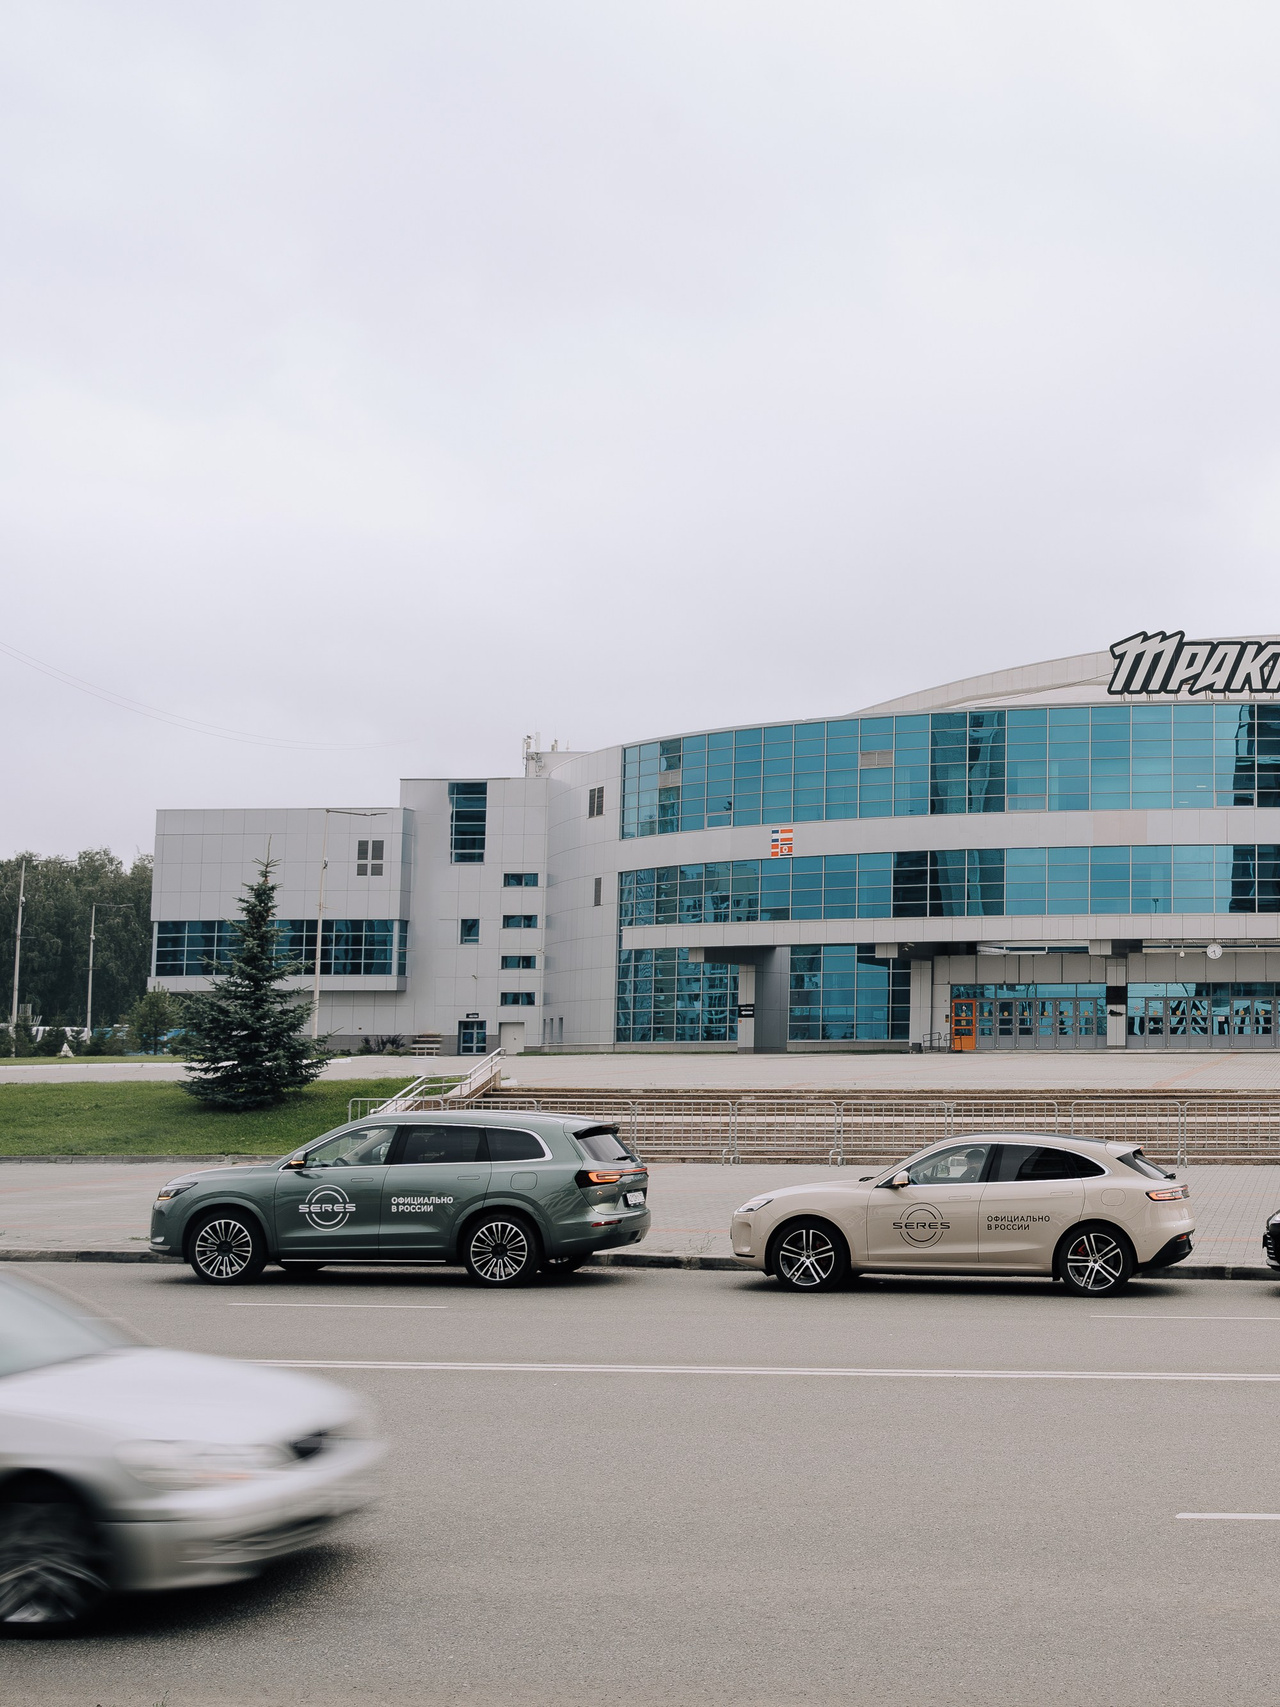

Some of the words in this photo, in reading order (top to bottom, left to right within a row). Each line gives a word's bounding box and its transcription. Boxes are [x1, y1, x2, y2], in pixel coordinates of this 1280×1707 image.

[391, 1196, 454, 1205] ОФИЦИАЛЬНО
[299, 1203, 356, 1213] SERES
[987, 1215, 1050, 1223] ОФИЦИАЛЬНО
[893, 1221, 950, 1230] SERES
[987, 1223, 993, 1231] В
[995, 1223, 1030, 1231] РОССИИ
